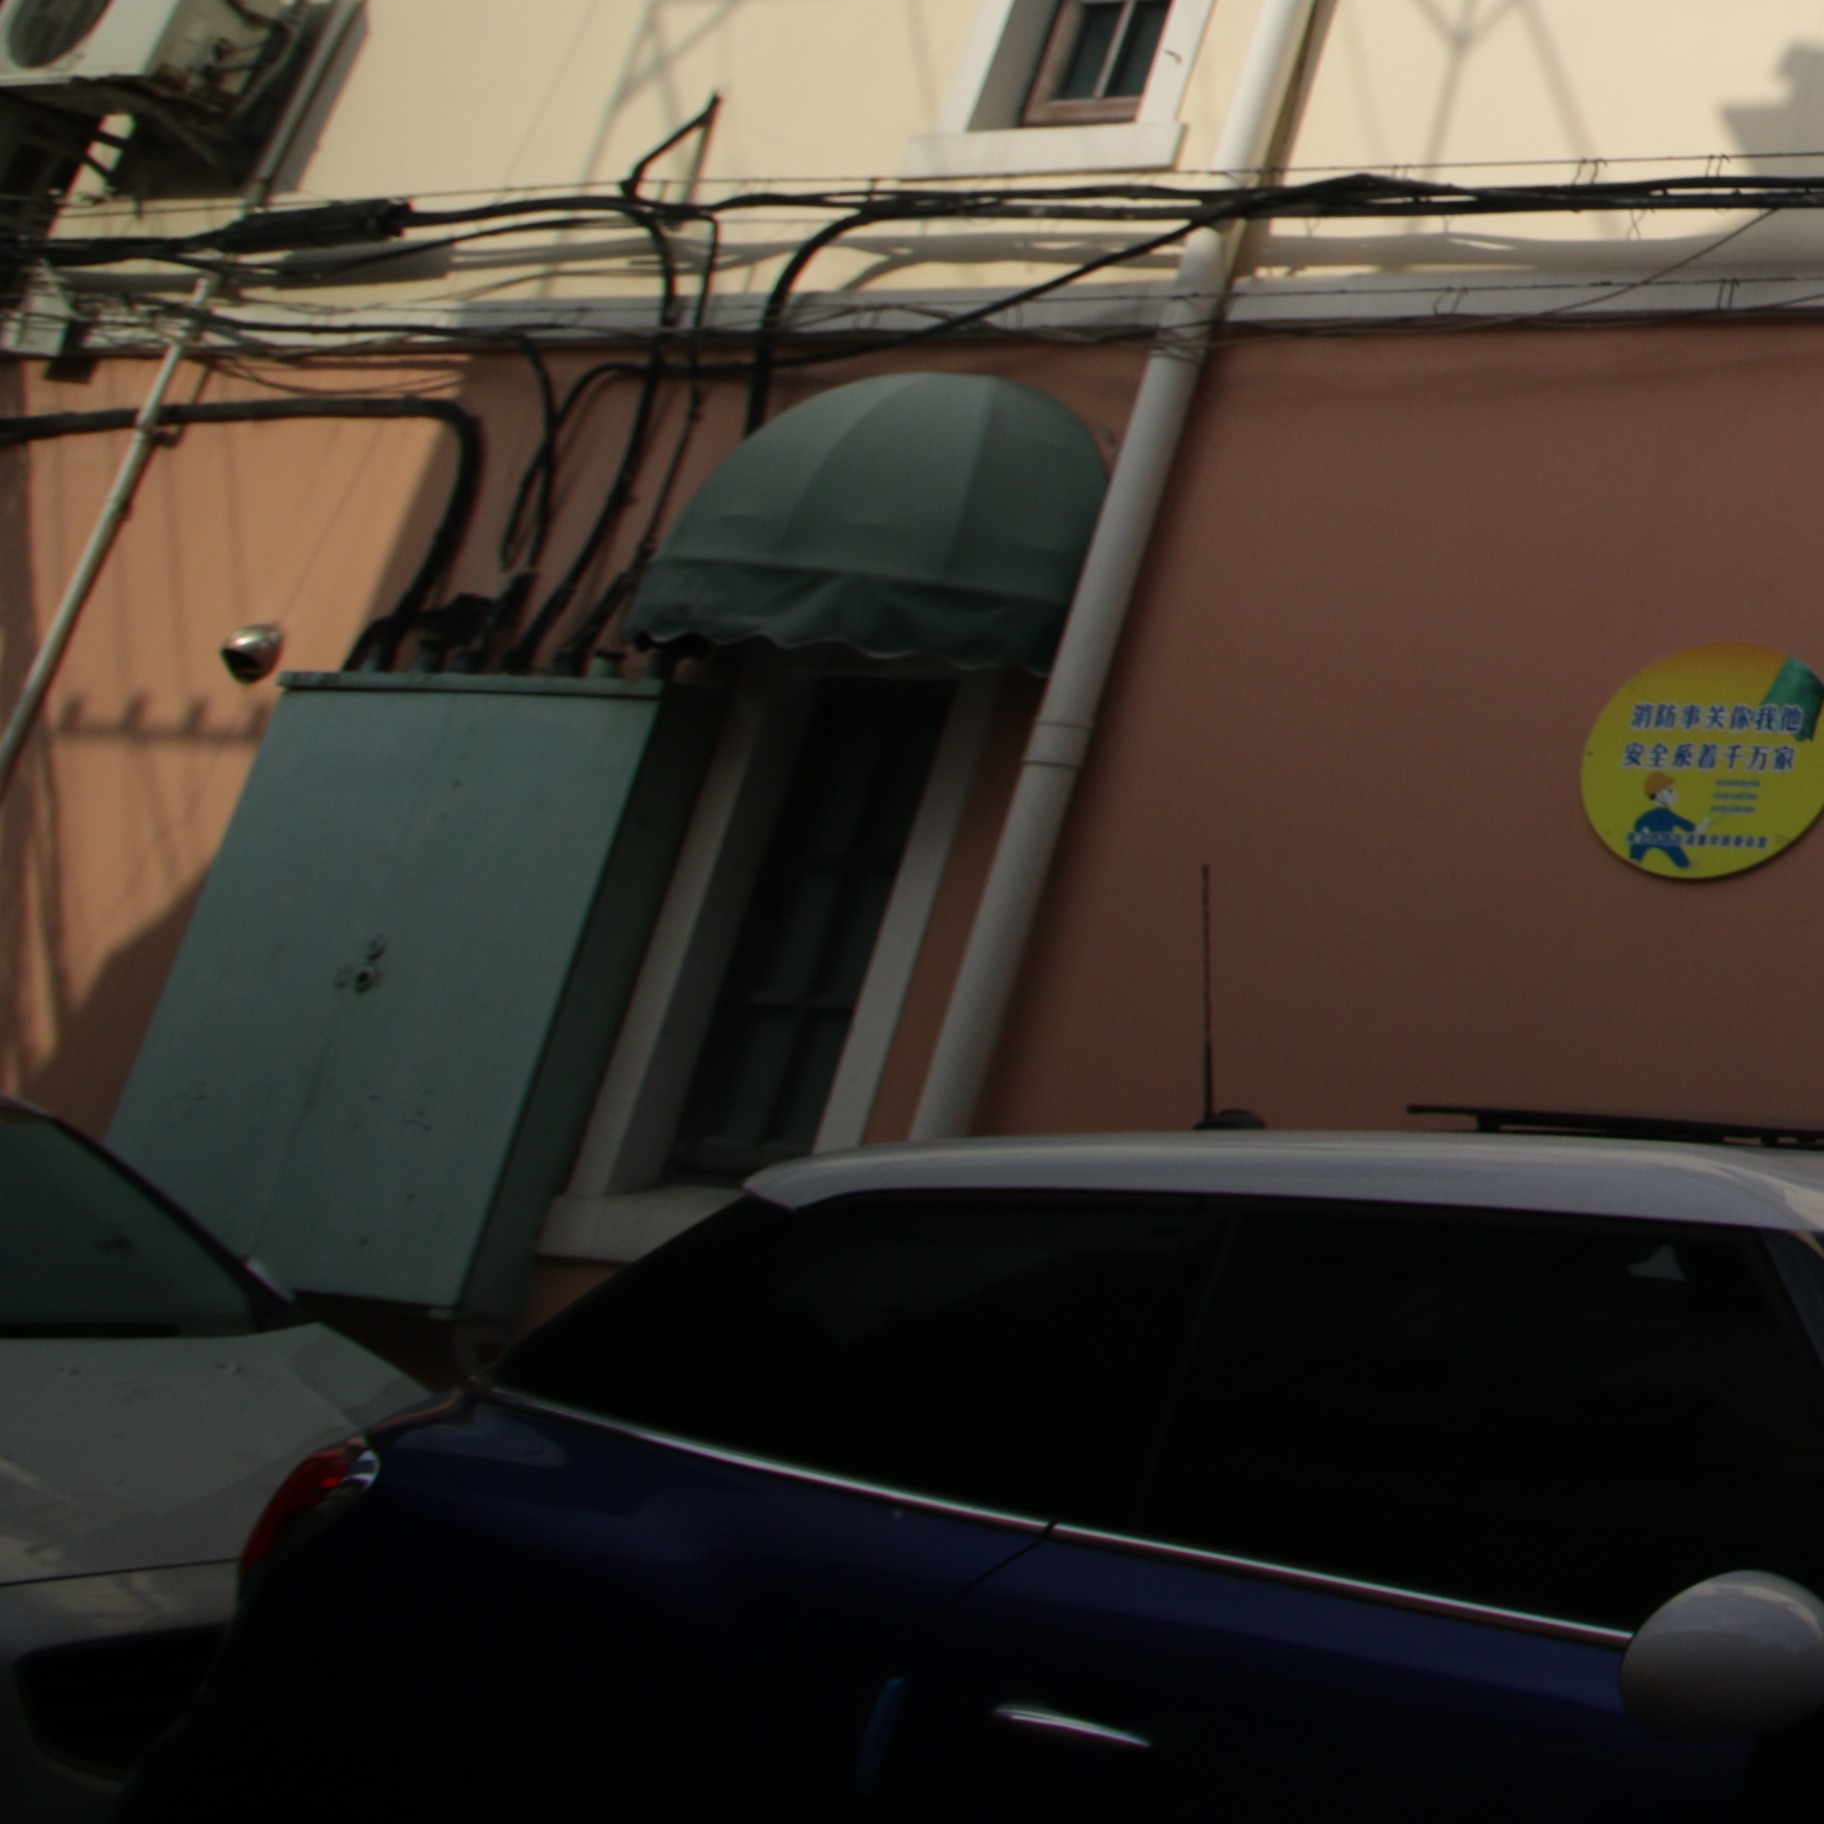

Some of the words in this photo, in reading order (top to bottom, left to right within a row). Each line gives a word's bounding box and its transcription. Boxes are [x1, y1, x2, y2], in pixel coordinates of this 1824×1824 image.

[1630, 702, 1804, 733] 消防事关你我他
